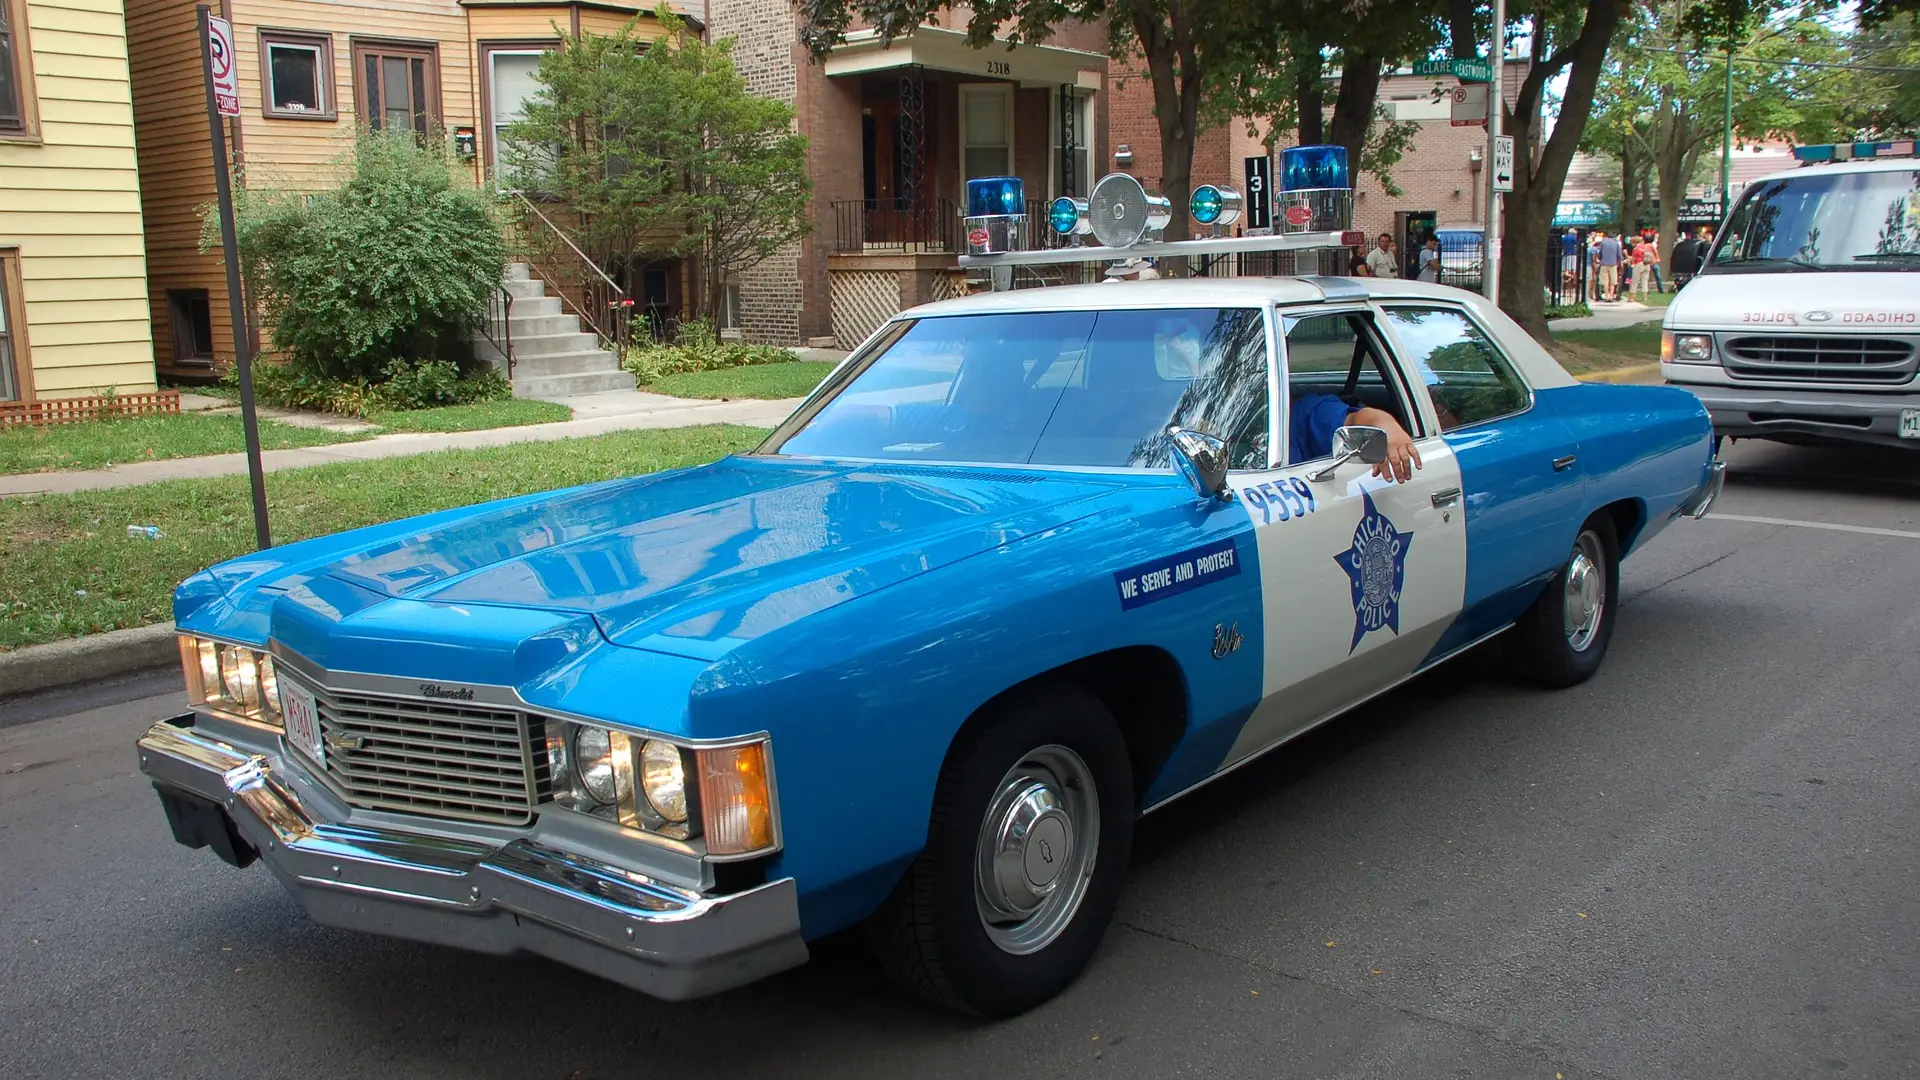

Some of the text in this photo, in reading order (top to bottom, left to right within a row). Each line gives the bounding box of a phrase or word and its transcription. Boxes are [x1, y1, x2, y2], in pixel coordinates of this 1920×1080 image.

[987, 60, 1011, 76] 2318
[1459, 63, 1486, 79] EASTWOOD
[1496, 140, 1511, 154] ONE
[1496, 156, 1511, 169] WAY
[1243, 476, 1315, 526] 9559
[1351, 514, 1401, 570] CHICAGO
[1120, 548, 1235, 600] WE SERVE AND PROTECT
[1355, 584, 1401, 628] POLICE
[419, 683, 474, 700] Chevrolet
